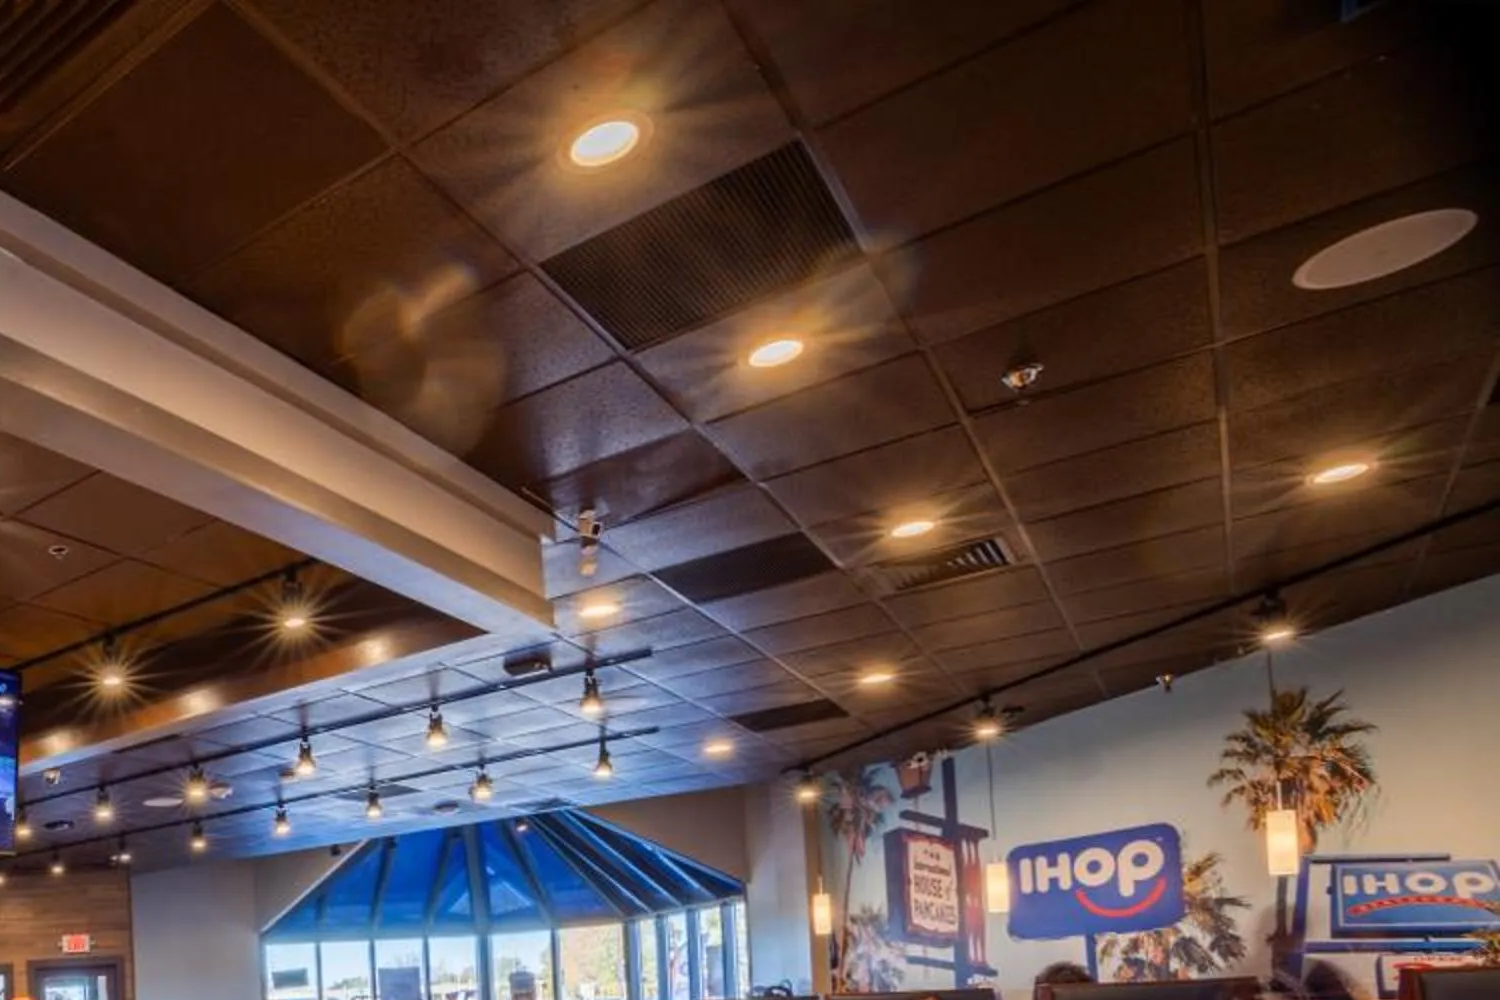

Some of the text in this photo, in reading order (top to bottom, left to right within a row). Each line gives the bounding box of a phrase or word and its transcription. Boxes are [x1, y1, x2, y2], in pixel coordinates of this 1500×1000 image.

[1019, 839, 1165, 898] IHOP
[913, 873, 943, 899] HOUSE
[1342, 871, 1496, 900] IHOP
